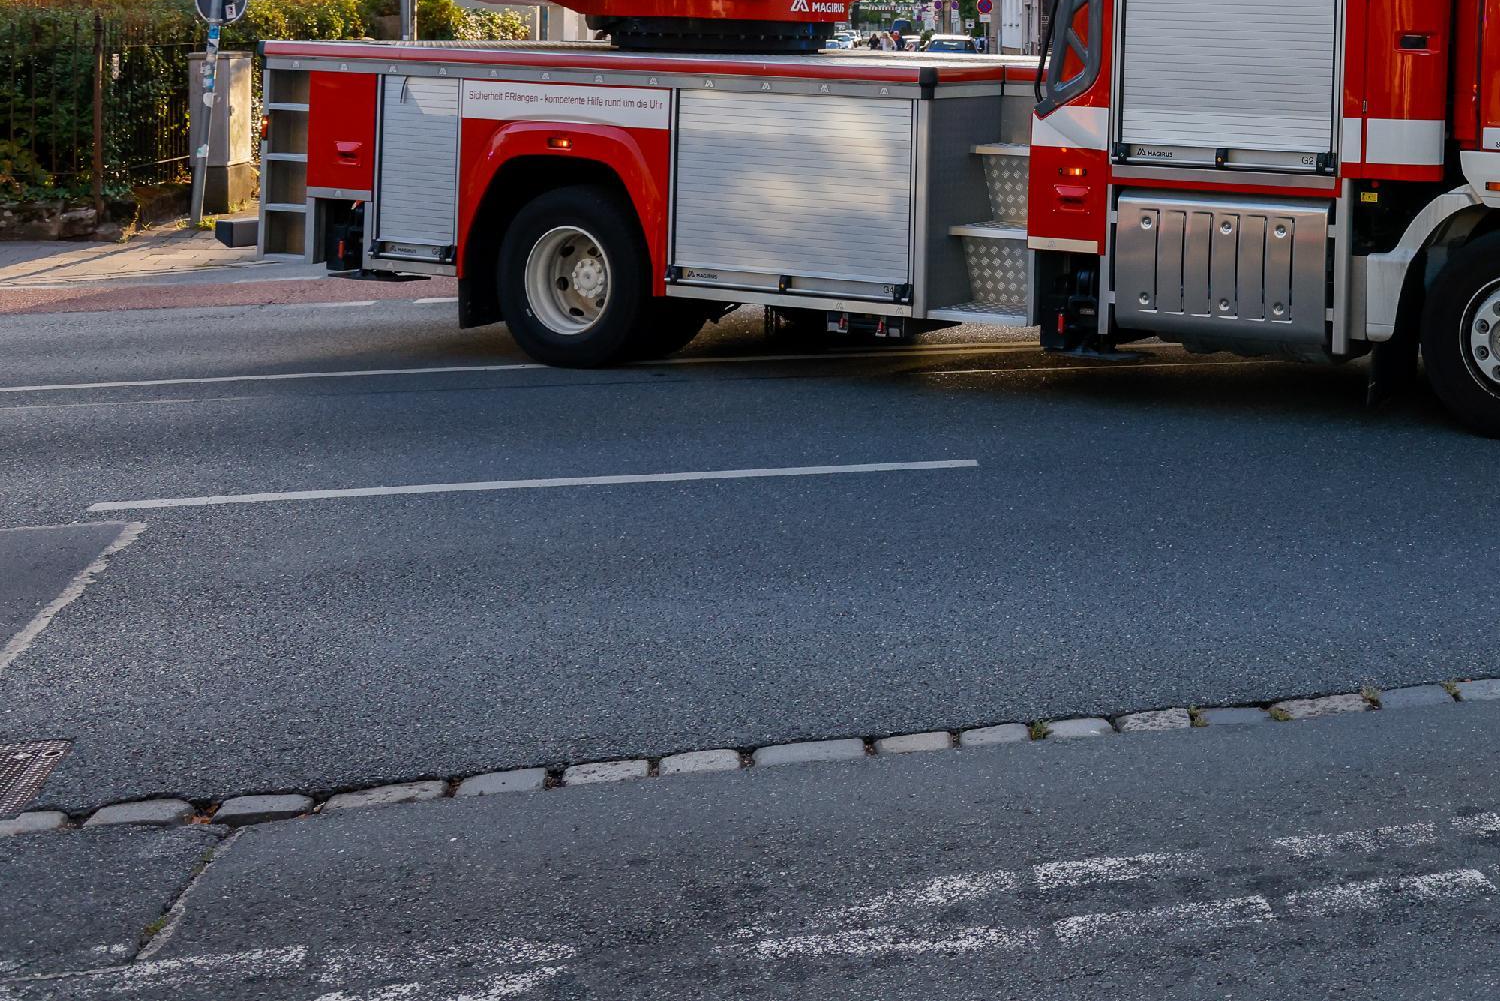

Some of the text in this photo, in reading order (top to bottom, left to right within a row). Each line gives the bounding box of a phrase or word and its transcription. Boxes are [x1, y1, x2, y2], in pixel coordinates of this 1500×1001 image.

[811, 1, 845, 13] MAGIRUS
[469, 90, 503, 101] Sicherheit
[636, 99, 648, 109] die
[649, 99, 663, 110] Uhr
[1147, 150, 1173, 158] MAGIRUS
[1301, 156, 1314, 165] G2
